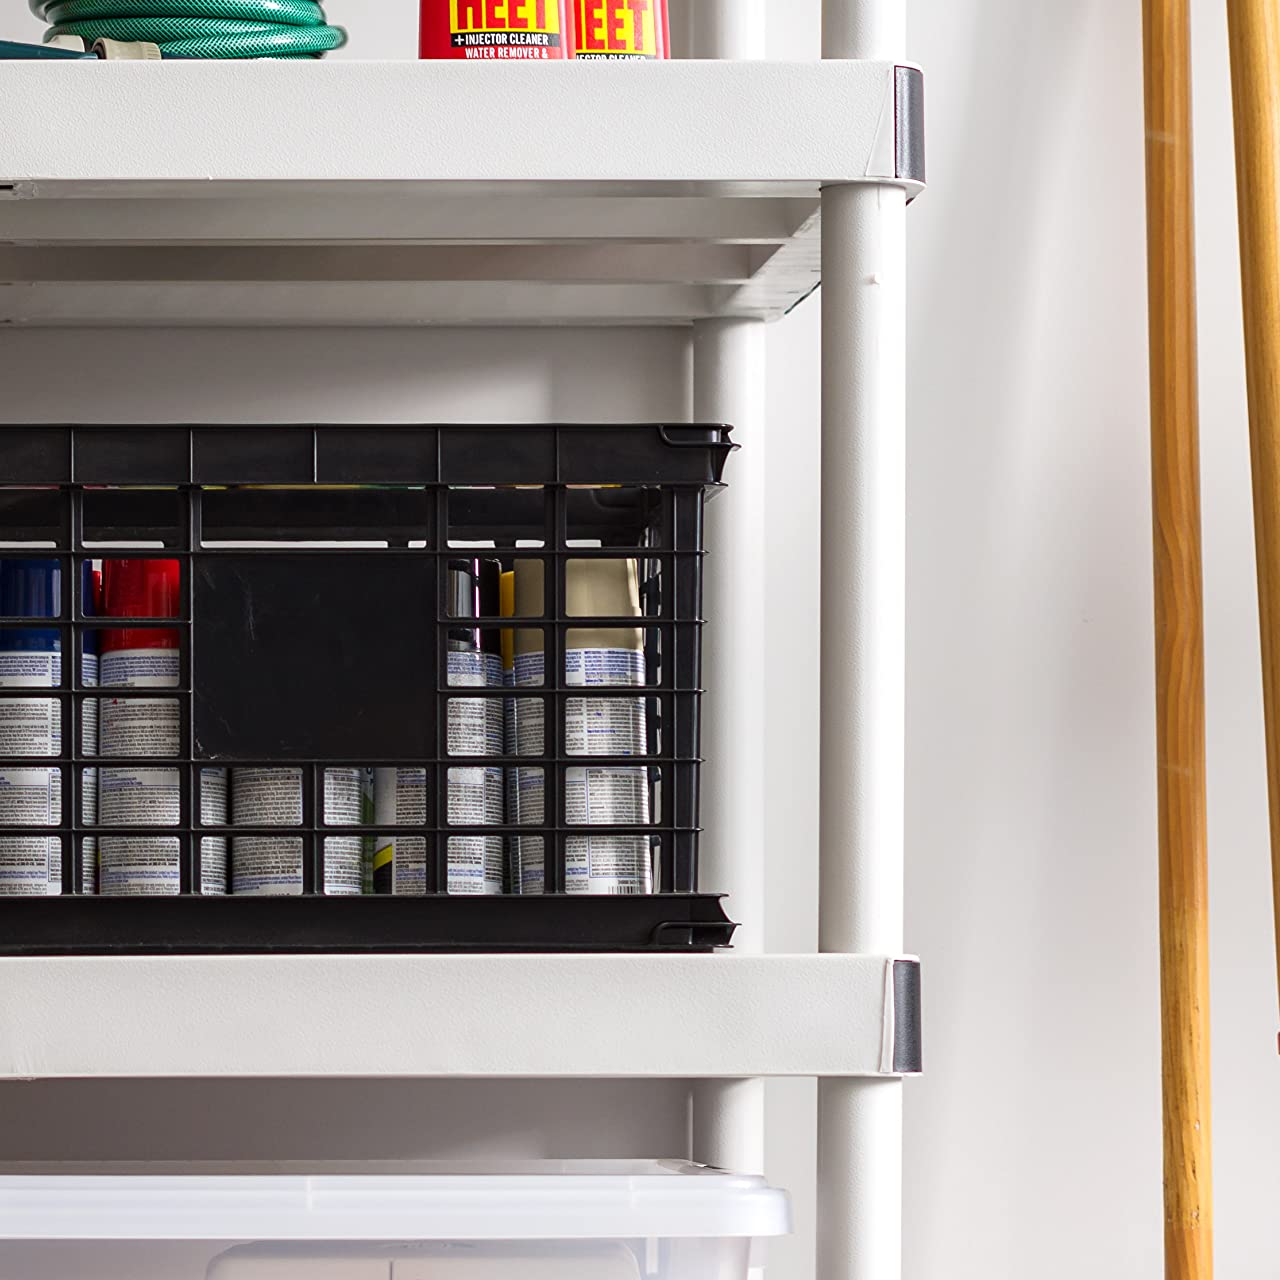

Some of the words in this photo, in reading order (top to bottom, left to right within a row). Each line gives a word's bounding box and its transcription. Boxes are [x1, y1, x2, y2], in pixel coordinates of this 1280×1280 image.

[509, 33, 549, 45] CLEANER
[465, 47, 496, 59] WATER
[498, 47, 540, 59] REMOVER
[541, 47, 548, 59] &
